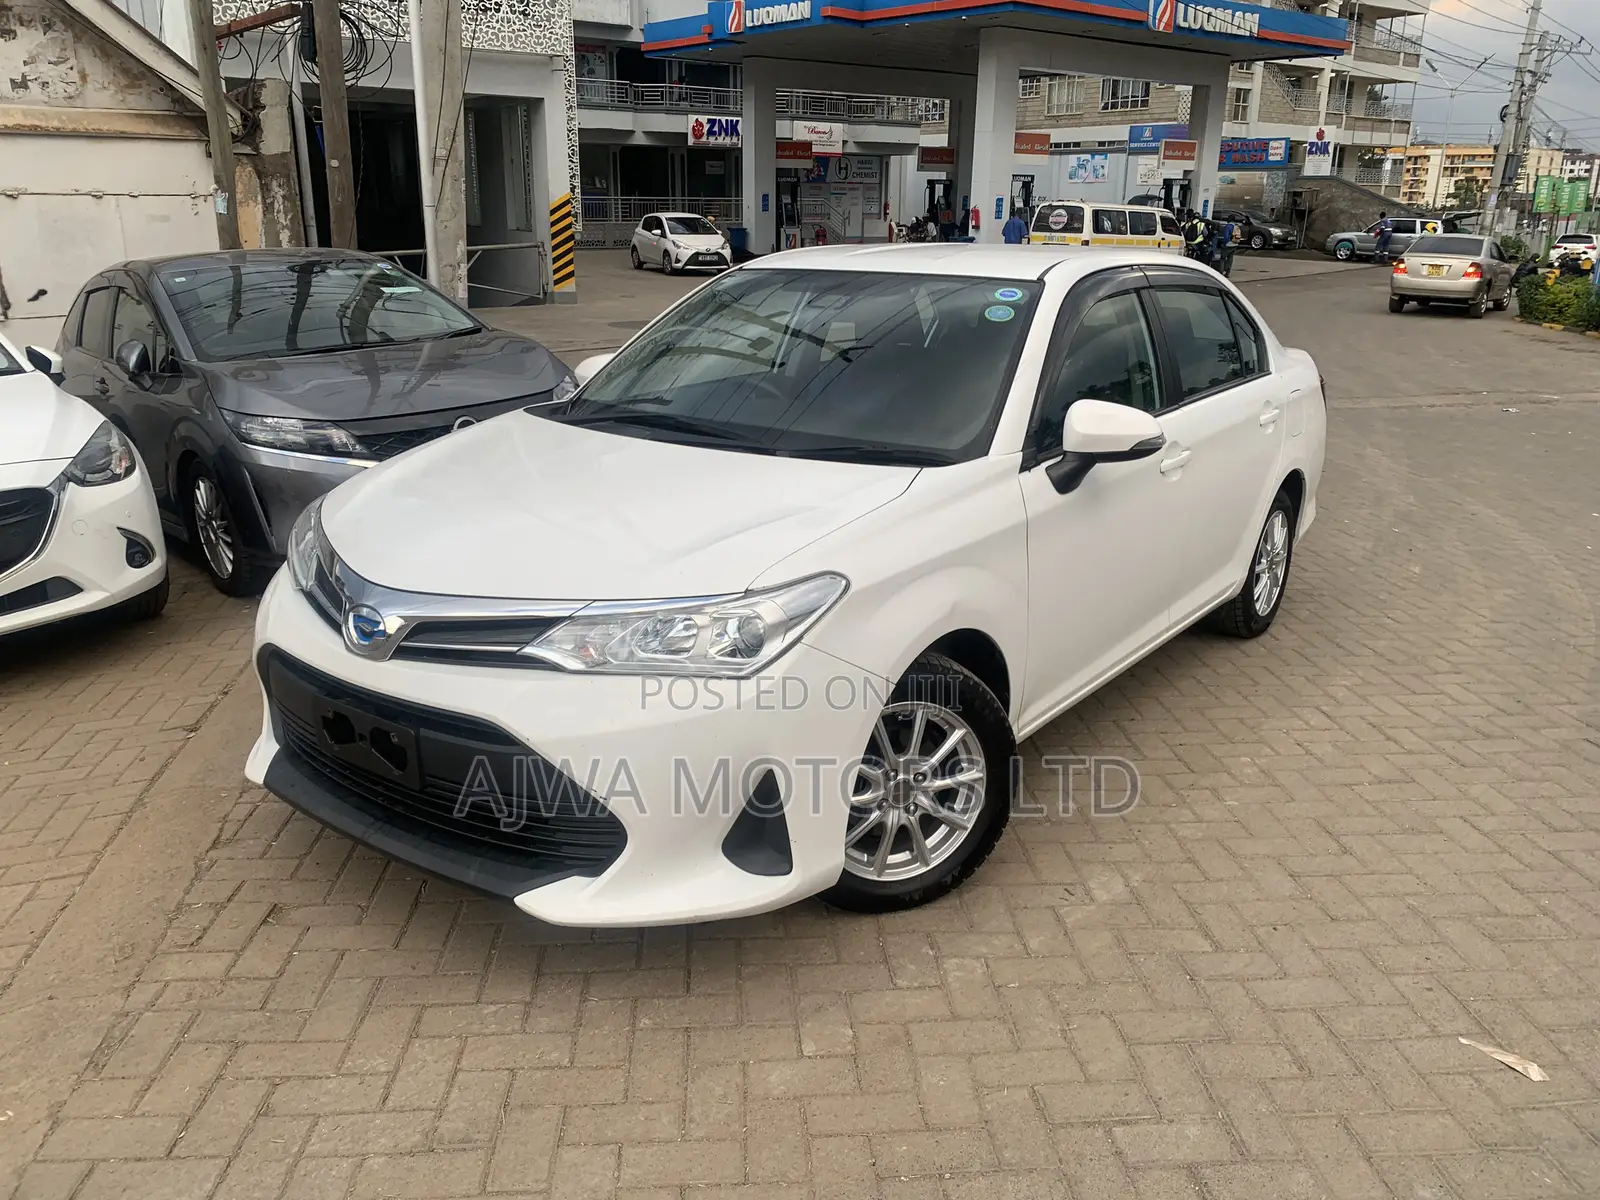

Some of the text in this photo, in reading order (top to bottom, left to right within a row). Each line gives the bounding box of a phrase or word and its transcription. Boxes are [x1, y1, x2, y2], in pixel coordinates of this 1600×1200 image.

[746, 1, 811, 27] LUQMAN
[1176, 2, 1260, 37] LUQMAN
[706, 118, 740, 136] ZNK
[1308, 141, 1331, 155] ZNK
[851, 171, 878, 179] CHEMIST
